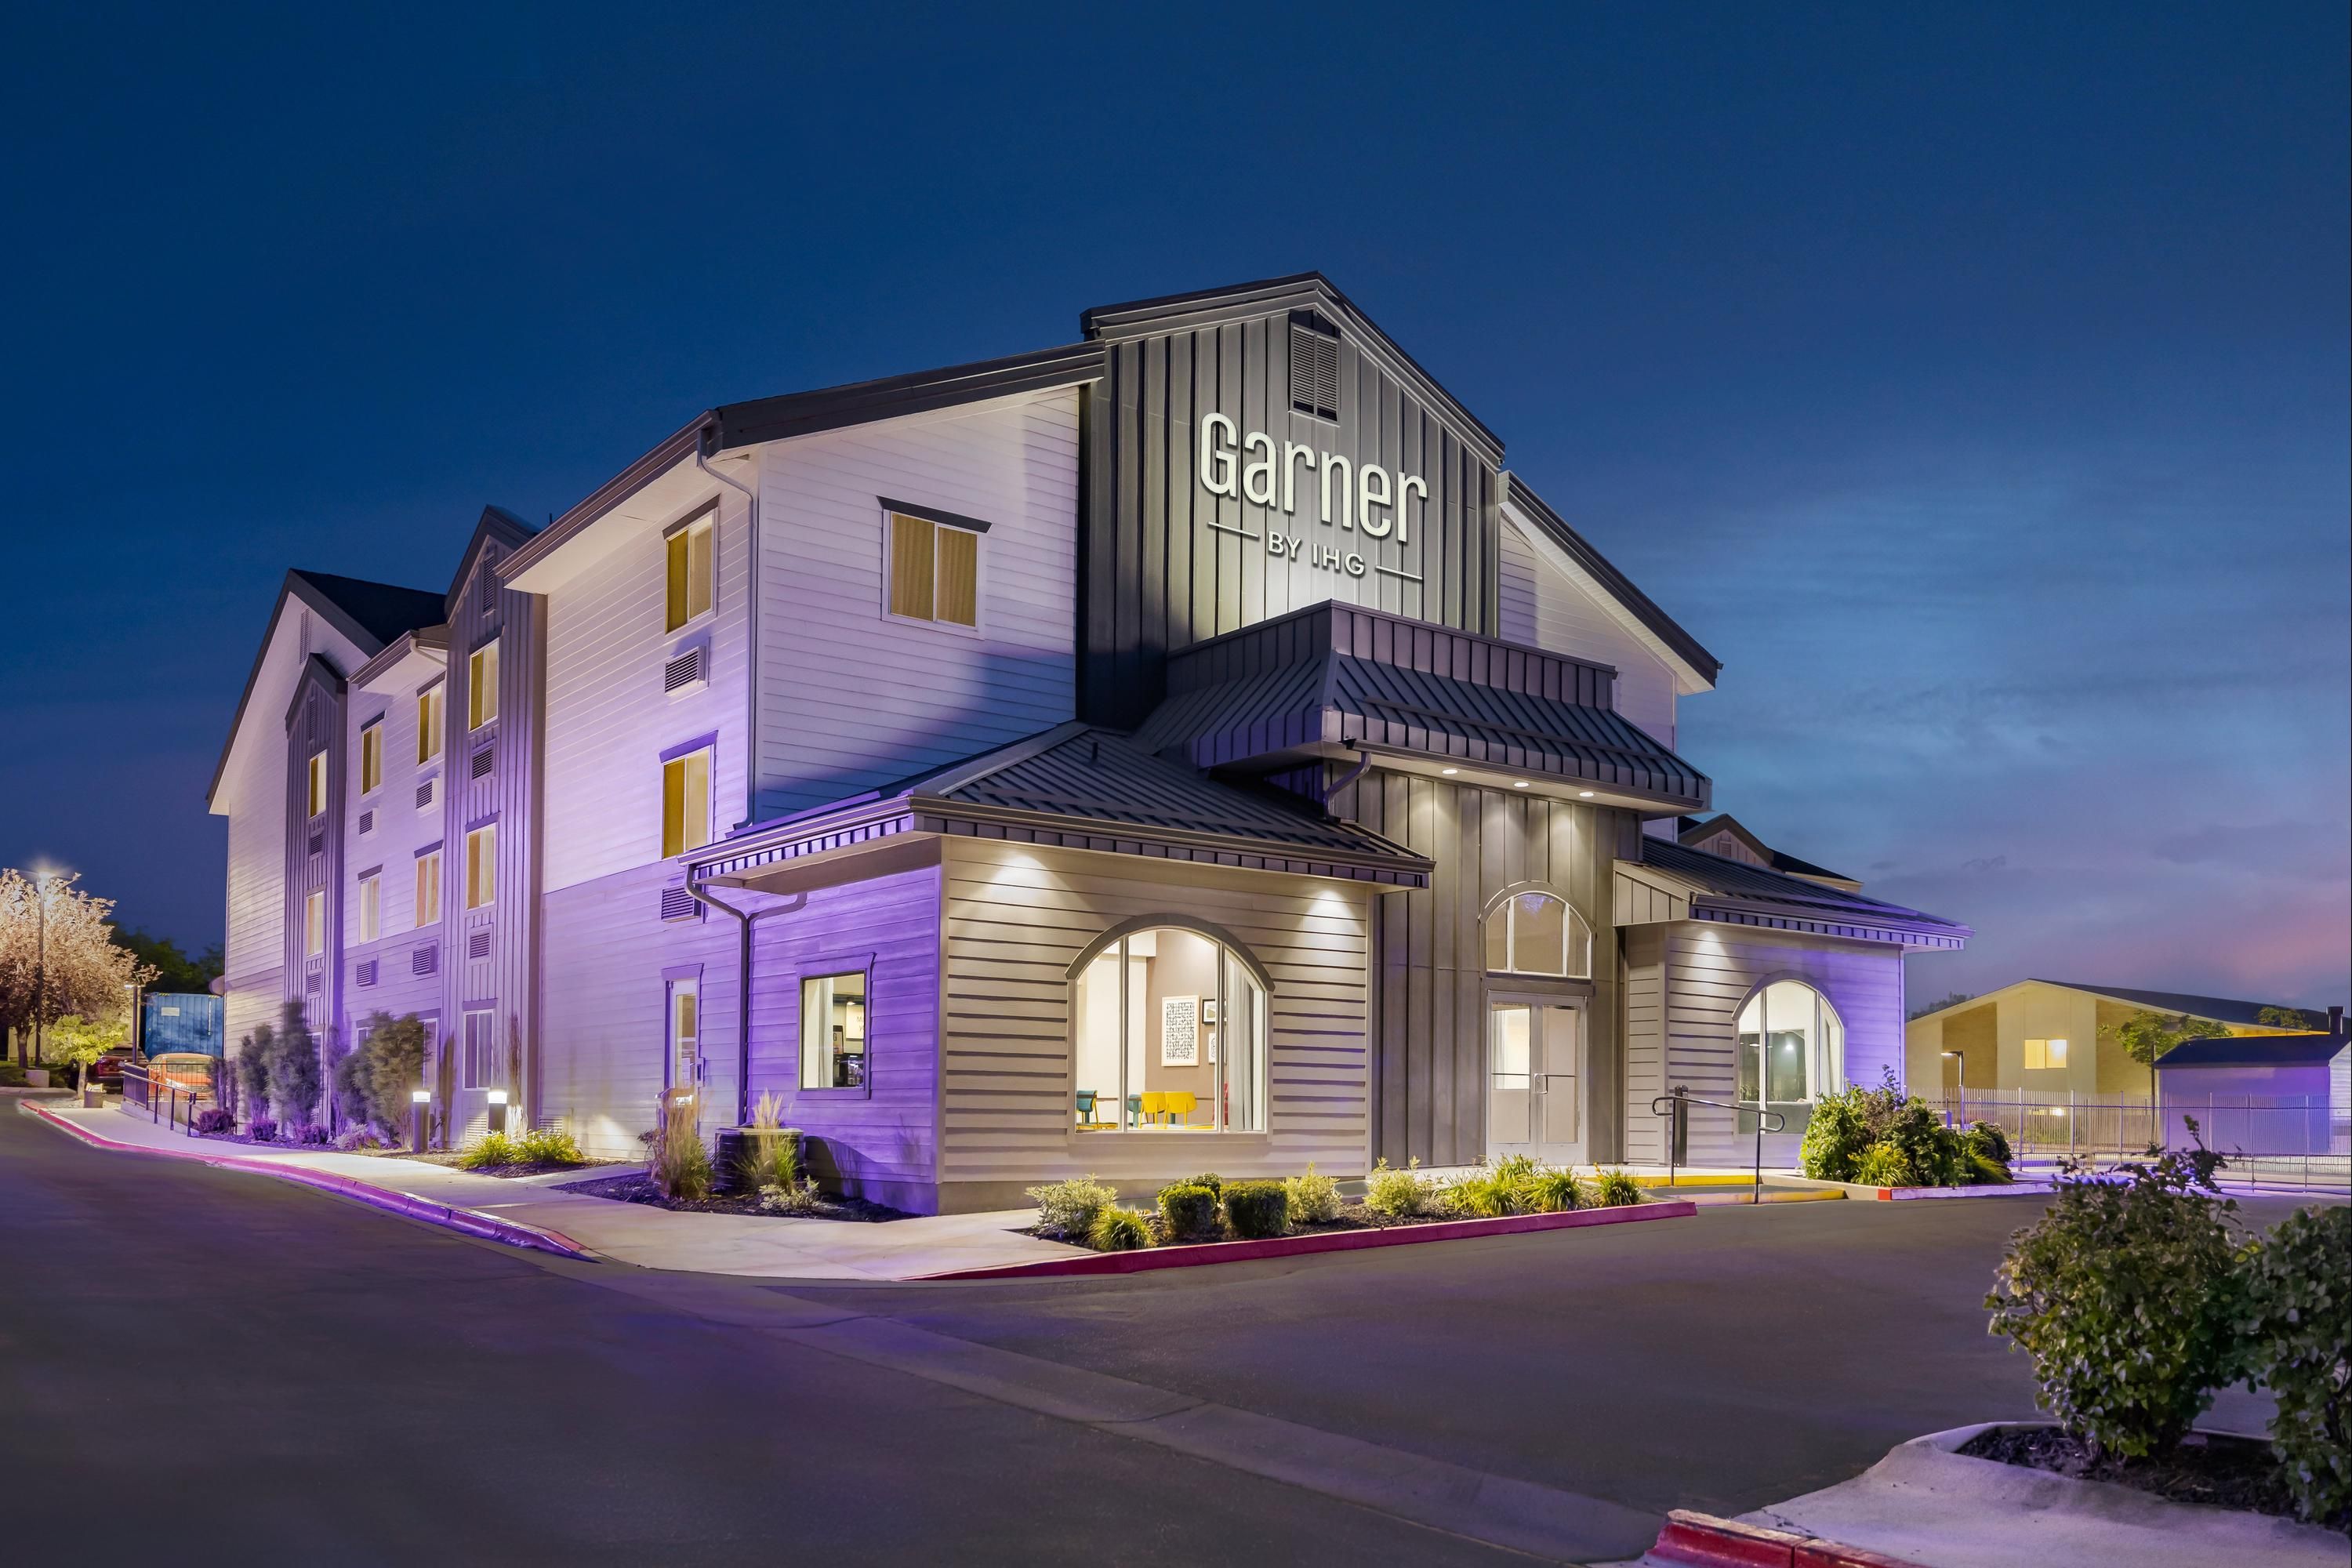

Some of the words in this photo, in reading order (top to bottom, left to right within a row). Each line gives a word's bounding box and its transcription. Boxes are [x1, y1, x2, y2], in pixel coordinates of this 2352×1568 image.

[1200, 412, 1428, 543] Garner
[1268, 531, 1301, 558] BY
[1312, 543, 1365, 575] IHG
